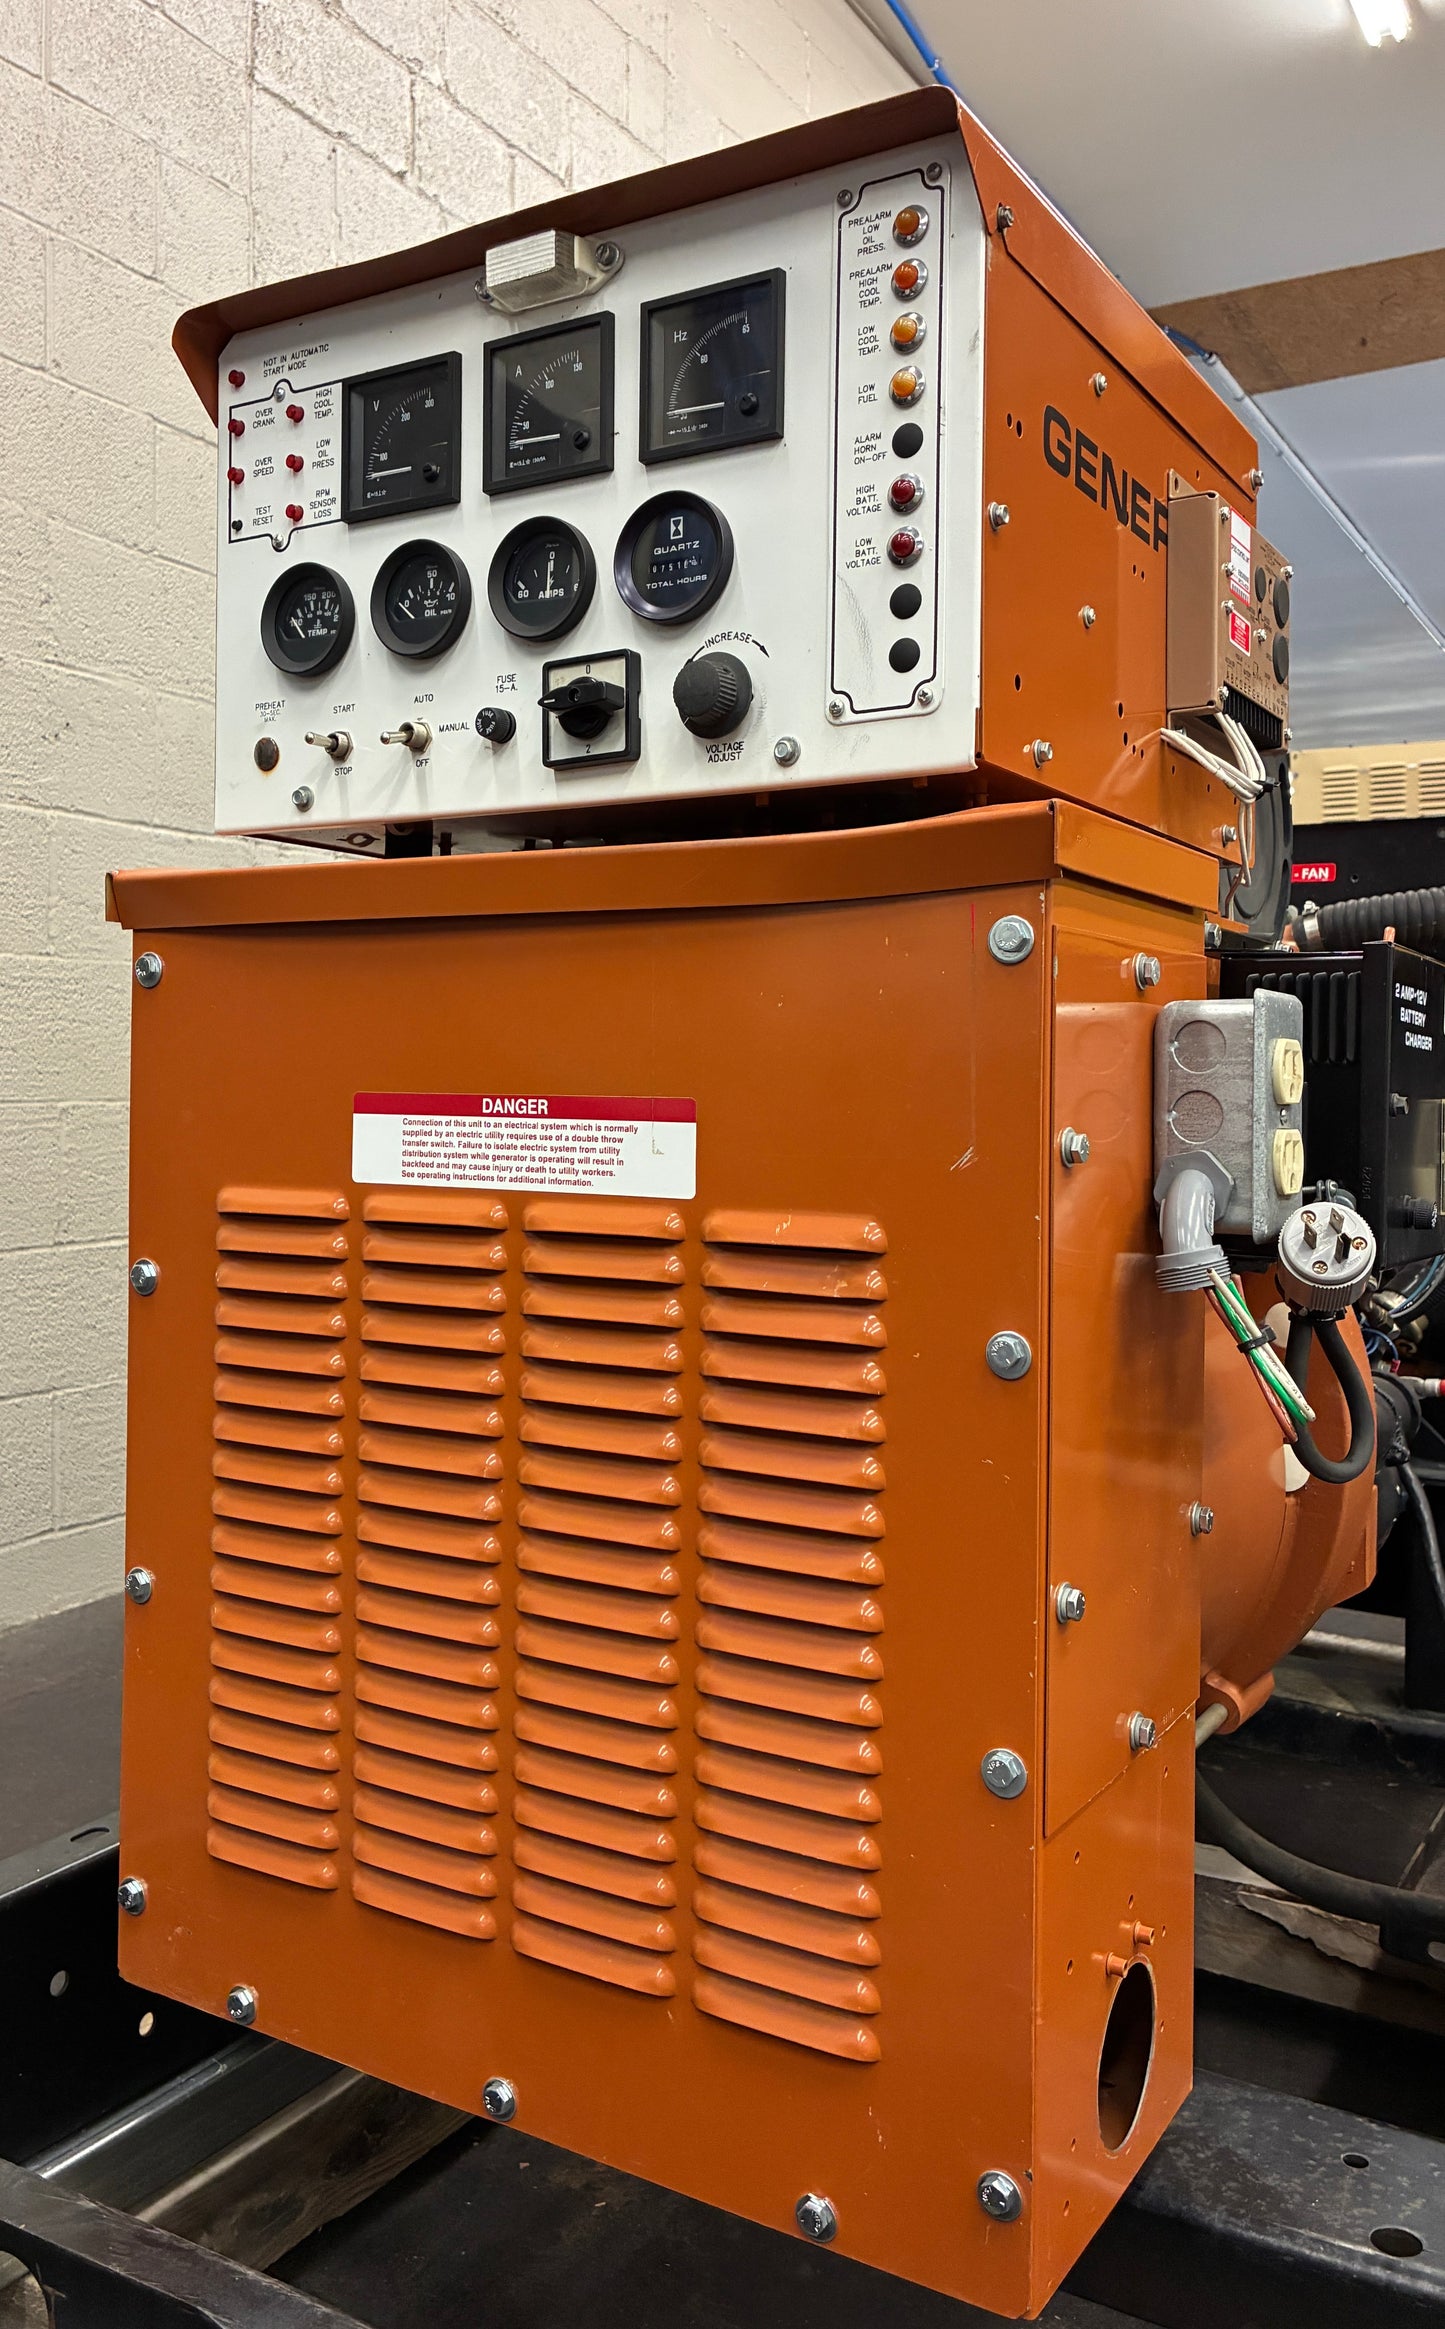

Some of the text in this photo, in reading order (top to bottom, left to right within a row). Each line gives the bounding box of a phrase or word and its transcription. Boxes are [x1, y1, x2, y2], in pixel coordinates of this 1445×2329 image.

[848, 210, 892, 228] PREALARM
[862, 224, 880, 234] LOW
[862, 236, 875, 244] OIL
[857, 242, 886, 257] PRESS.
[849, 262, 892, 280] PREALARM
[859, 276, 878, 288] HIGH
[859, 286, 880, 298] COOL
[859, 297, 882, 308] TEMP.
[742, 324, 750, 334] 65
[858, 324, 876, 336] LOW
[674, 330, 688, 343] Hz
[858, 335, 880, 346] COOL
[264, 344, 329, 367] NOT IN AUTOMATIC
[858, 345, 882, 356] TEMP.
[700, 355, 708, 364] 60
[264, 360, 307, 378] START MODE
[515, 365, 522, 378] A
[316, 388, 332, 398] HIGH
[858, 383, 876, 394] LOW
[858, 394, 878, 404] FUEL
[373, 400, 380, 412] V
[255, 408, 273, 418] OVER
[314, 409, 334, 419] TEMP.
[252, 417, 276, 428] CRANK
[522, 421, 530, 430] 50
[316, 438, 331, 448] LOW
[854, 432, 882, 444] ALARM
[318, 450, 328, 458] OIL
[854, 444, 876, 455] HORN
[255, 456, 272, 467] OVER
[312, 458, 334, 470] PRESS
[854, 452, 888, 465] ON-OFF
[252, 466, 274, 478] SPEED
[316, 488, 330, 498] RPM
[856, 484, 875, 495] HIGH
[310, 497, 336, 510] SENSOR
[856, 494, 878, 506] BATT.
[256, 506, 272, 516] TEST
[314, 509, 332, 519] LOSS
[846, 504, 882, 517] VOLTAGE
[252, 515, 274, 526] RESET
[654, 540, 700, 555] QUARTZ
[855, 537, 872, 548] LOW
[855, 546, 878, 558] BATT.
[846, 556, 882, 570] VOLTAGE
[427, 570, 437, 578] 50
[646, 574, 707, 590] TOTAL HOURS
[518, 590, 529, 598] 60
[404, 600, 410, 608] 0
[308, 628, 328, 637] TEMP
[704, 631, 752, 648] INCREASE
[496, 674, 516, 684] FUSE
[414, 694, 434, 704] AUTO
[255, 700, 286, 711] PREHEAT
[333, 704, 356, 714] START
[438, 722, 470, 732] MANUAL
[586, 744, 591, 754] 2
[706, 741, 744, 754] VOLTAGE
[416, 758, 430, 768] OFF
[708, 751, 742, 764] ADJUST
[334, 766, 352, 776] STOP
[1302, 867, 1329, 880] FAN
[1394, 982, 1400, 998] 2
[1400, 1006, 1427, 1028] BATTERY
[1405, 1031, 1432, 1052] CHARGER
[482, 1098, 548, 1115] DANGER
[403, 1118, 443, 1126] Connection
[445, 1119, 452, 1127] of
[468, 1120, 482, 1128] unit
[504, 1121, 538, 1130] electrical
[541, 1123, 567, 1131] system
[570, 1123, 592, 1131] which
[604, 1124, 638, 1134] normally
[402, 1129, 432, 1137] supplied
[435, 1130, 443, 1138] by
[484, 1132, 504, 1140] utility
[506, 1134, 538, 1142] requires
[458, 1141, 482, 1149] Failure
[520, 1144, 548, 1152] electric
[550, 1145, 577, 1154] system
[599, 1146, 620, 1156] utility
[402, 1150, 441, 1158] distribution
[444, 1152, 468, 1160] system
[470, 1152, 489, 1160] while
[492, 1154, 528, 1162] generator
[538, 1156, 575, 1165] operating
[592, 1157, 614, 1165] result
[617, 1158, 624, 1166] in
[402, 1160, 434, 1169] backfeed
[436, 1161, 449, 1169] and
[452, 1163, 466, 1171] may
[492, 1163, 513, 1173] injury
[525, 1165, 546, 1173] death
[559, 1167, 579, 1176] utility
[582, 1168, 616, 1177] workers.
[417, 1171, 450, 1181] operating
[453, 1172, 494, 1182] instructions
[496, 1174, 506, 1182] for
[508, 1174, 546, 1184] additional
[548, 1176, 594, 1187] information.
